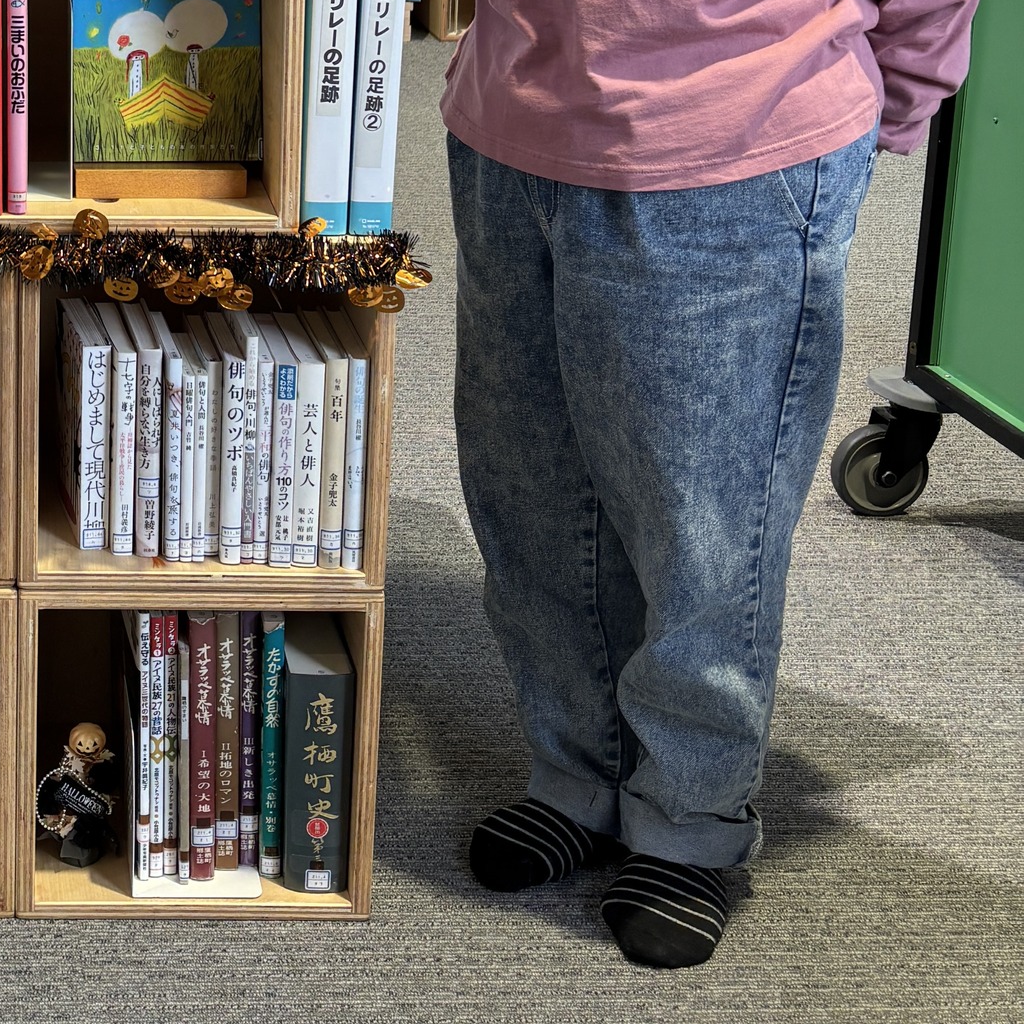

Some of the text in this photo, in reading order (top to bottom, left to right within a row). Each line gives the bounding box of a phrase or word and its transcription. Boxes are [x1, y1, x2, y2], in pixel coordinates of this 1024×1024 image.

[10, 16, 25, 114] 三まいのおふだ
[139, 364, 151, 469] 自分を縛らない生き方
[151, 376, 162, 448] 人にしばられず
[185, 382, 193, 427] 日曜俳句入門
[198, 381, 206, 420] 俳句と人間
[227, 361, 246, 462] 俳句のツボ
[244, 388, 256, 440] 俳句・川柳
[279, 368, 287, 398] よくわかる
[330, 394, 343, 422] 百年
[334, 378, 341, 391] 句集
[276, 403, 293, 511] 俳句の作り方110のコツ
[299, 403, 319, 487] 芸人と俳人
[144, 499, 155, 541] 曽野綾子
[297, 507, 306, 541] 堀本裕樹
[306, 508, 314, 541] 又吉直樹
[328, 472, 338, 507] 金子兜太
[140, 632, 149, 666] 伝え守る
[194, 643, 213, 726] オサラッペ慕情
[218, 637, 235, 719] オサラッペ慕情
[241, 633, 258, 714] オサラッペ慕情
[141, 671, 149, 728] アイヌ三世代の物語
[151, 659, 163, 736] アイヌ民族27の昔話
[166, 658, 176, 735] アイヌ民族21の人物伝
[265, 648, 280, 728] たかすの自然
[303, 692, 339, 819] 鷹栖町史
[61, 782, 102, 815] HALLOWEEN
[265, 752, 277, 832] オサラッペ慕情・別巻
